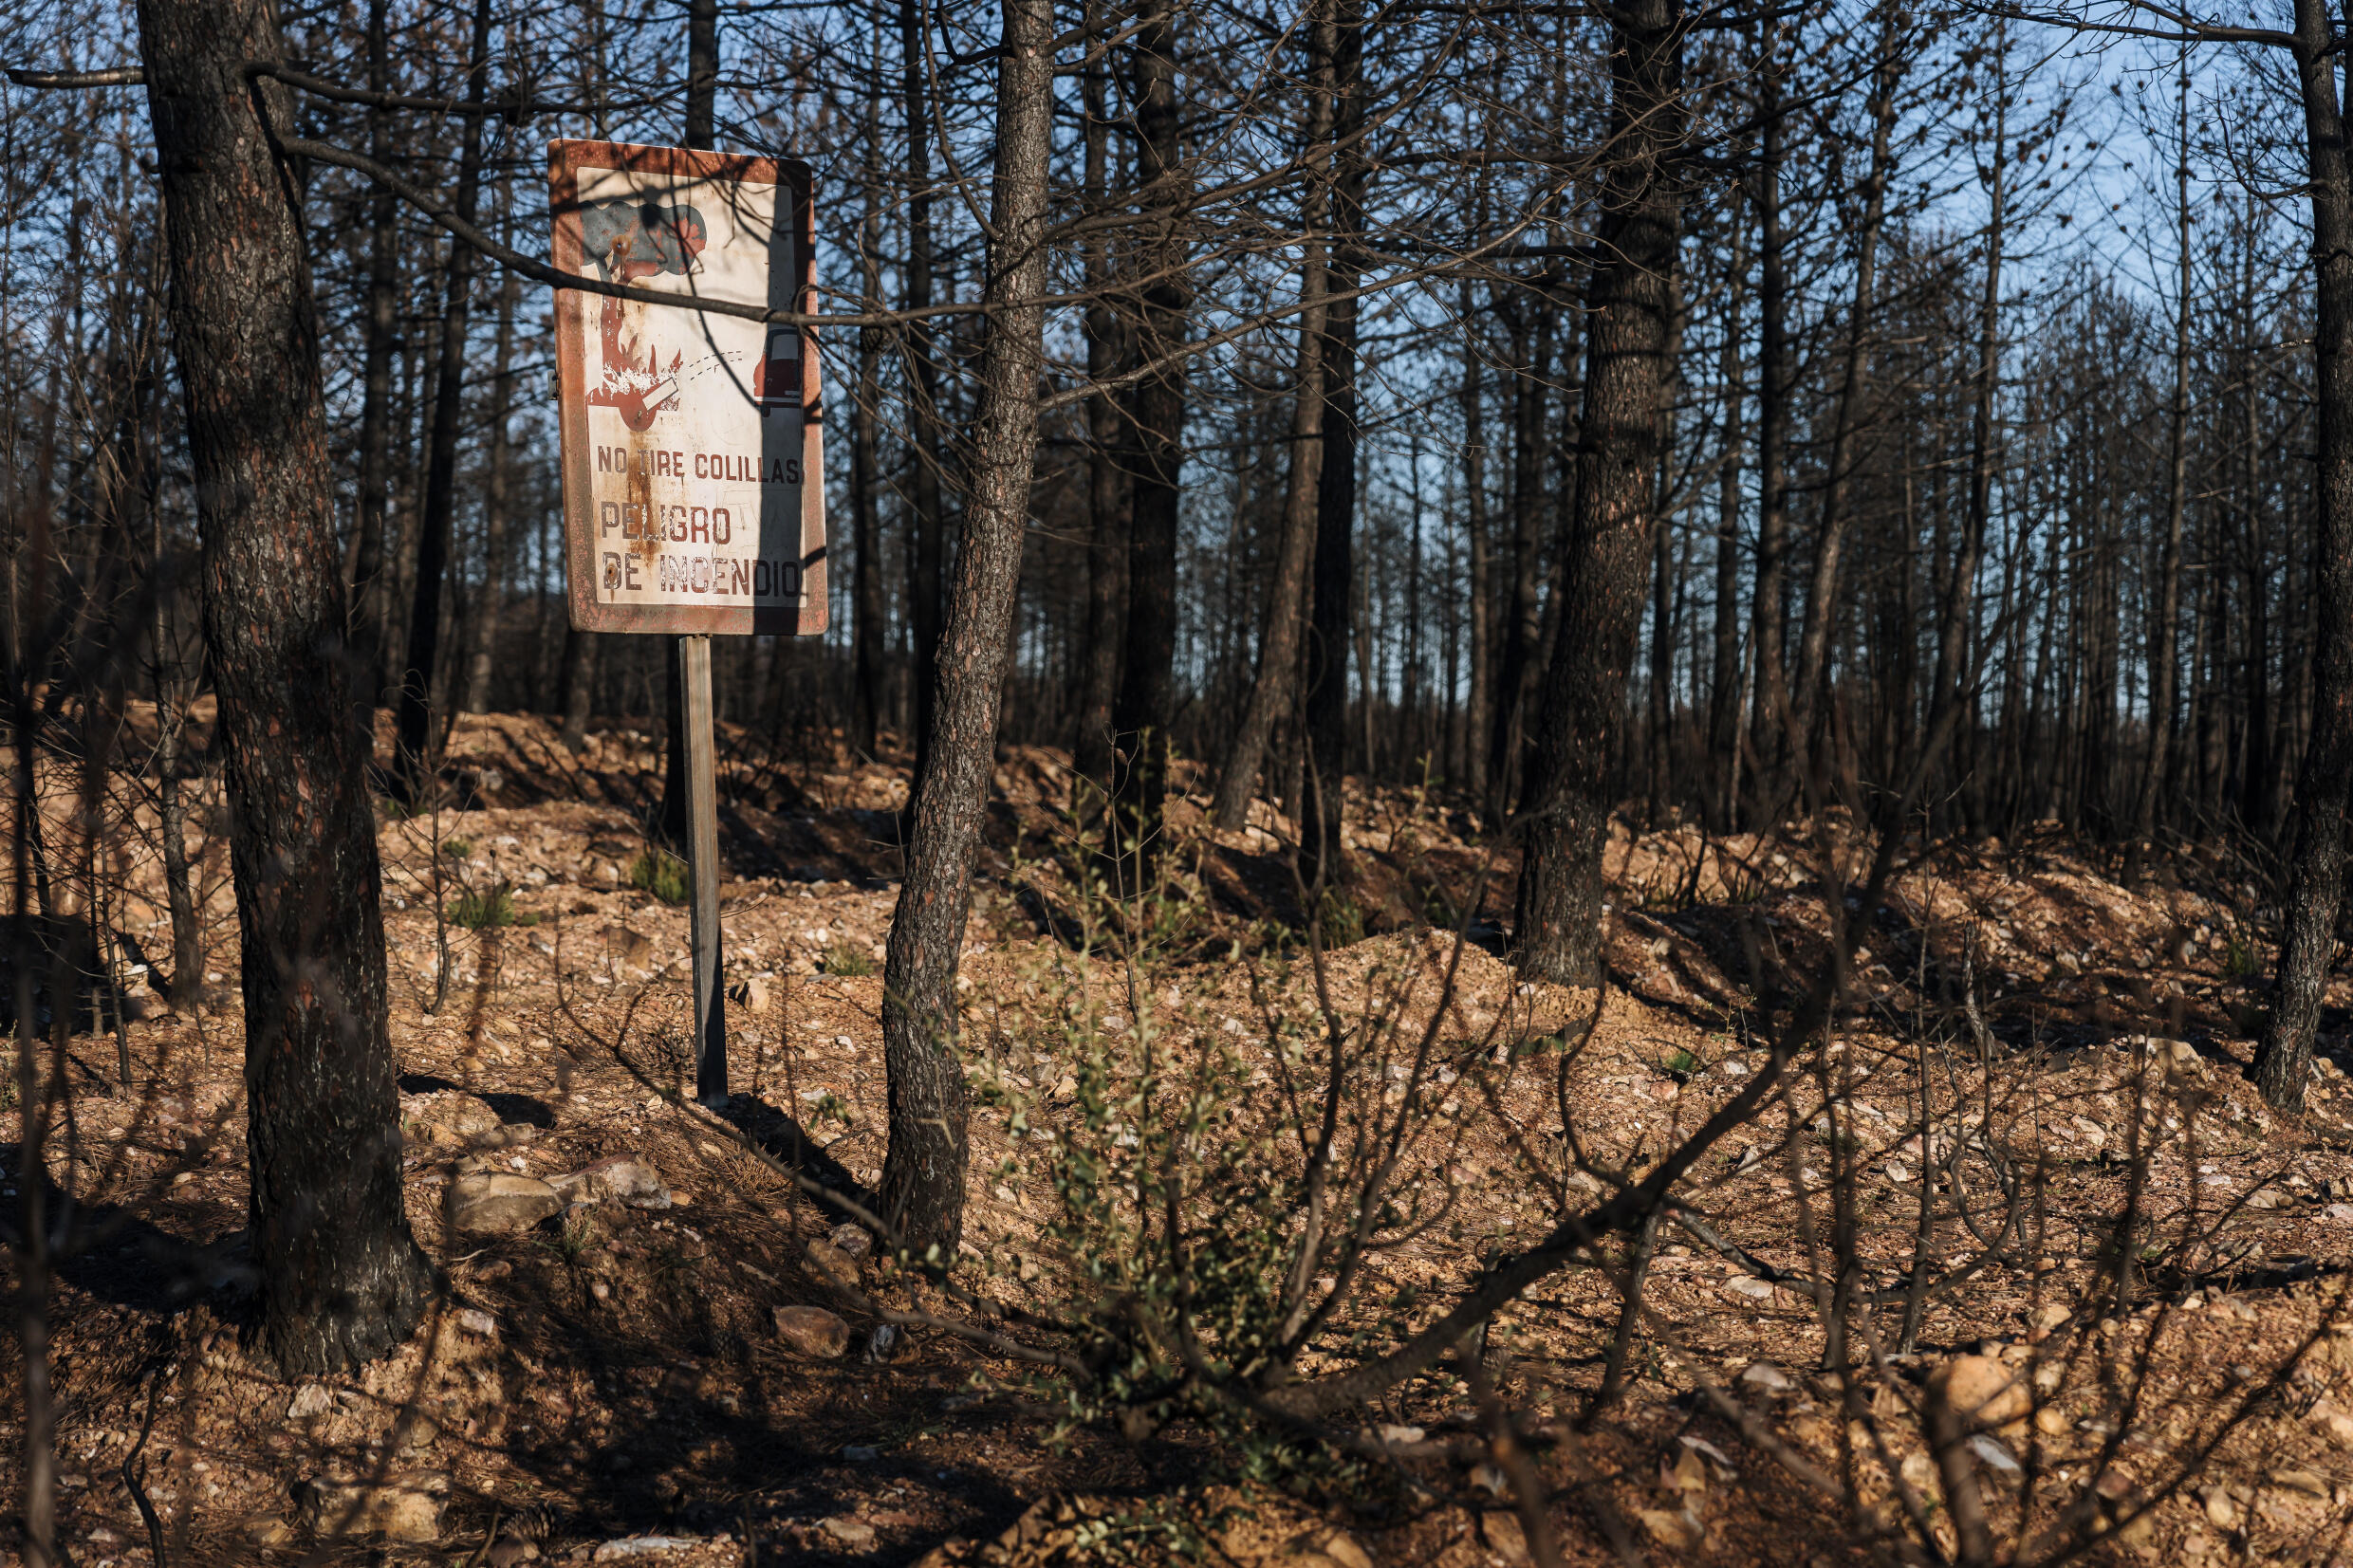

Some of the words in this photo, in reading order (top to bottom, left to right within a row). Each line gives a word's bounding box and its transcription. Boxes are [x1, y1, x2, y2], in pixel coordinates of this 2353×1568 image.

[598, 446, 627, 473] NO
[637, 449, 685, 477] TIRE
[695, 453, 799, 484] COLILLAS
[601, 501, 732, 545] PELIGRO
[602, 551, 642, 591] DE
[660, 554, 801, 597] INCENDIO
